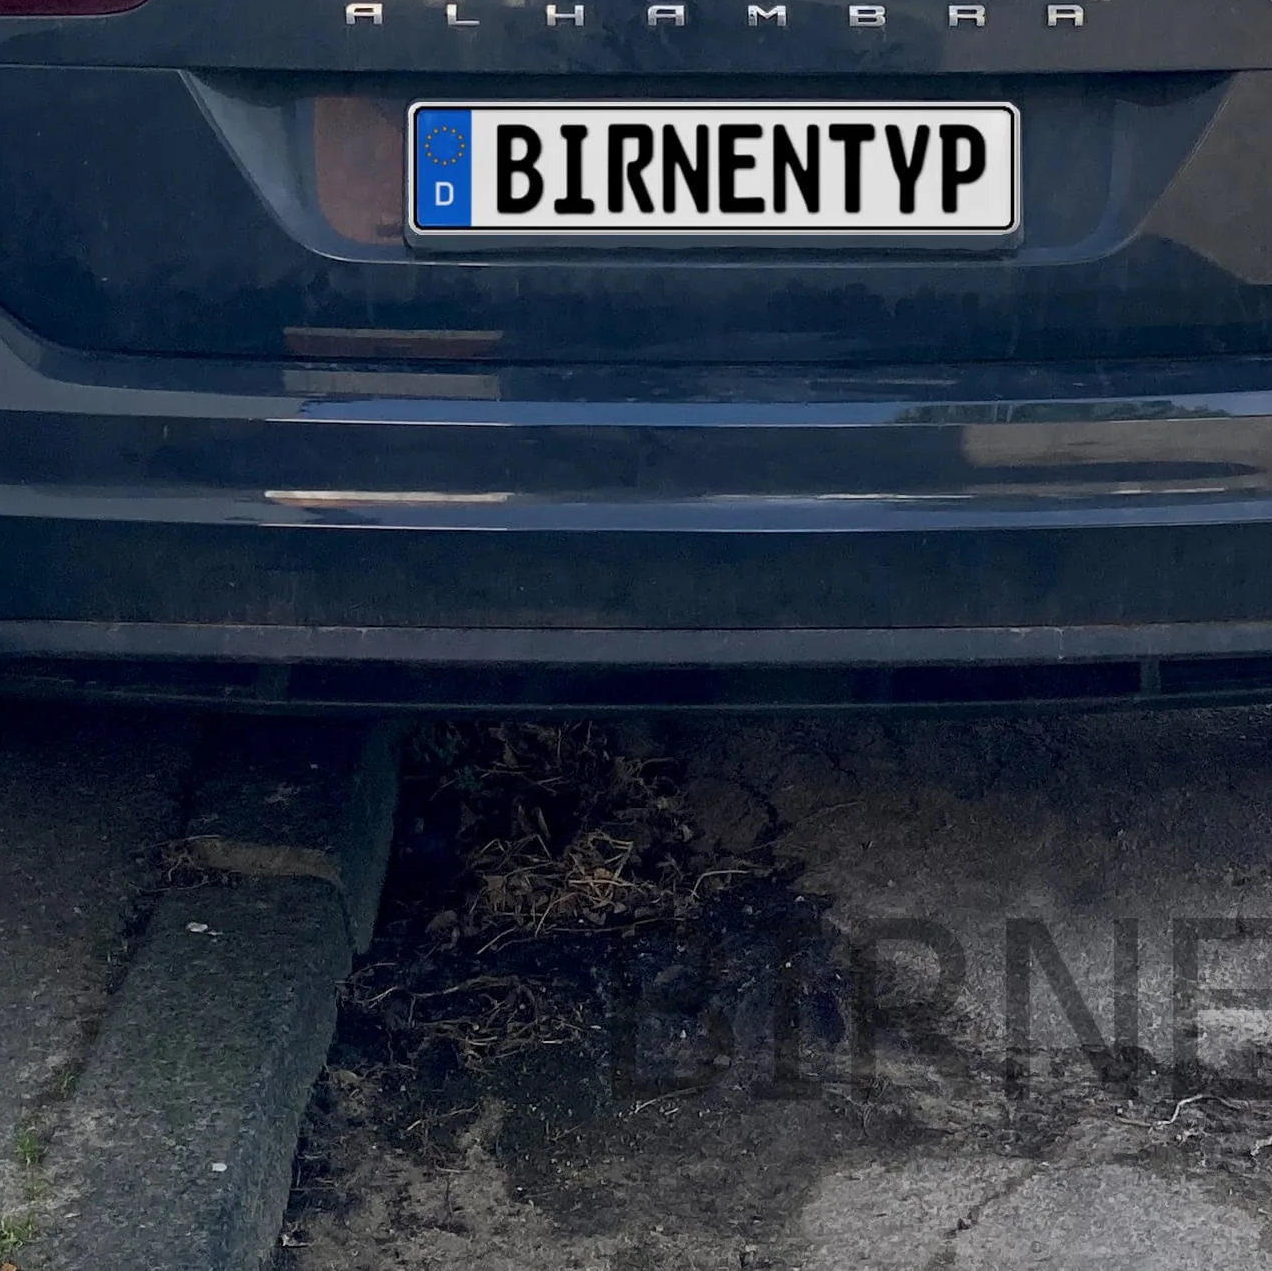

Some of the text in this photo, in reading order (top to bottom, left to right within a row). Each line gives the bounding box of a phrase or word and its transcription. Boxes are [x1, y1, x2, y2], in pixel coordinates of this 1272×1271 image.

[345, 2, 1085, 27] ALHAMBRA
[435, 123, 986, 214] D BIRNENTYP
